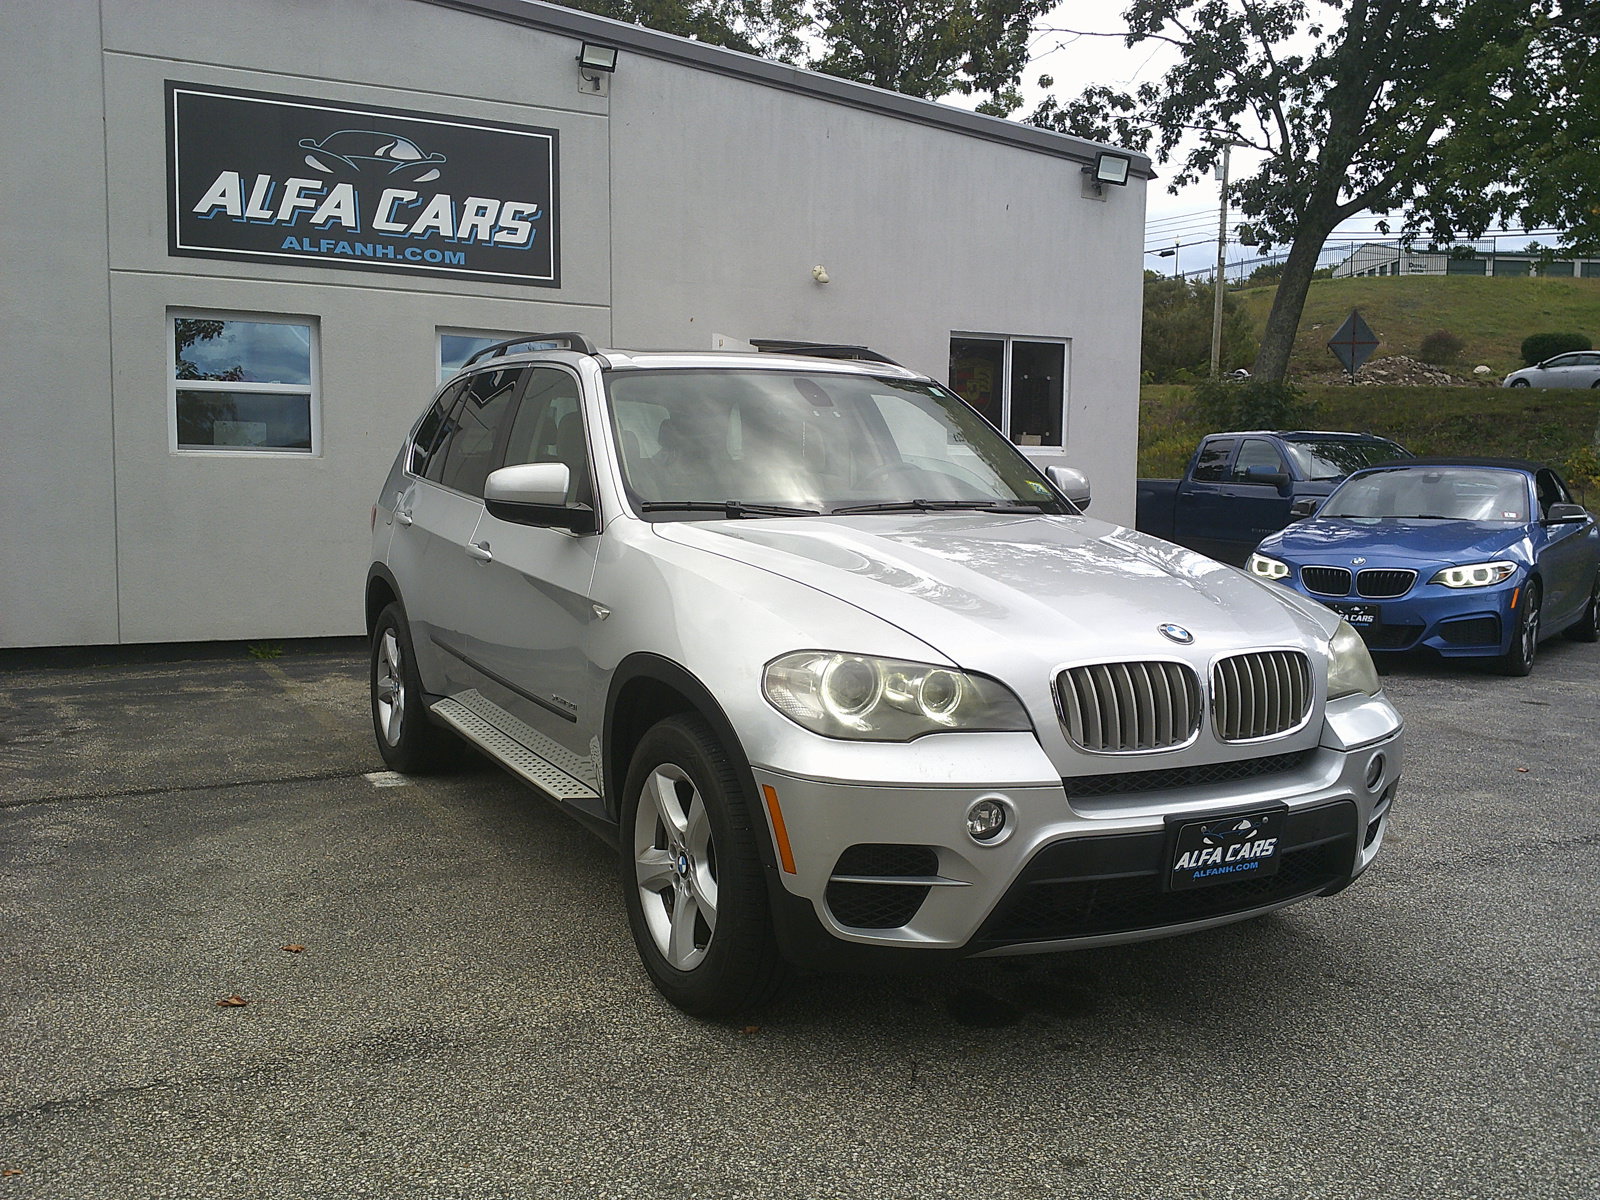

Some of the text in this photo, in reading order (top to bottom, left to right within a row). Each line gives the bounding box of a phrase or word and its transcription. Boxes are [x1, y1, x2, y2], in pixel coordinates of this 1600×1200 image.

[192, 171, 541, 248] ALFA CARS
[281, 235, 466, 265] ALFANH.COM
[1173, 838, 1278, 870] ALFA CARS
[1192, 862, 1258, 878] ALFANH.COM
